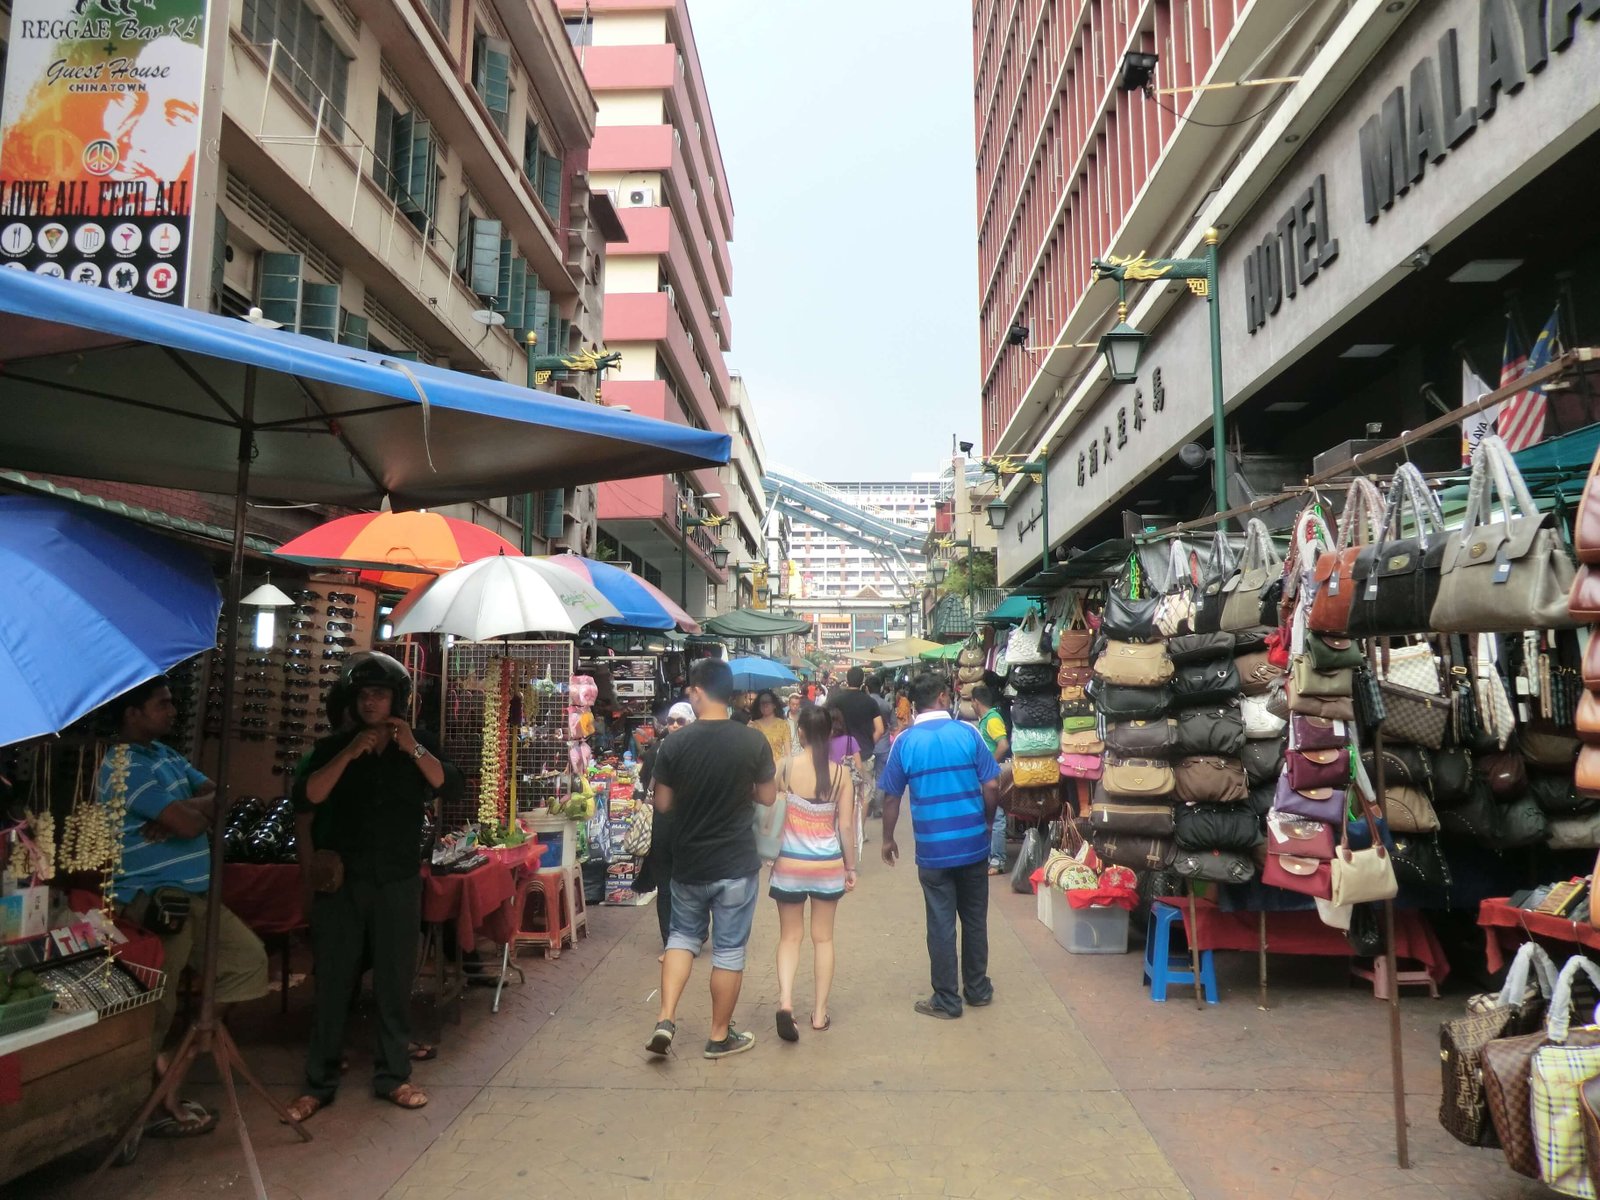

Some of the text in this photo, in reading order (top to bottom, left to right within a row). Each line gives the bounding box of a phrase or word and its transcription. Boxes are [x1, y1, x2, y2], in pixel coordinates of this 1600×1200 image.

[21, 18, 197, 40] REGGAE Bar KL
[46, 58, 171, 87] Guest House
[69, 83, 147, 93] CHINATOWN
[0, 180, 191, 217] LOVE ALL FEED ALL
[1243, 174, 1339, 335] HOTEL
